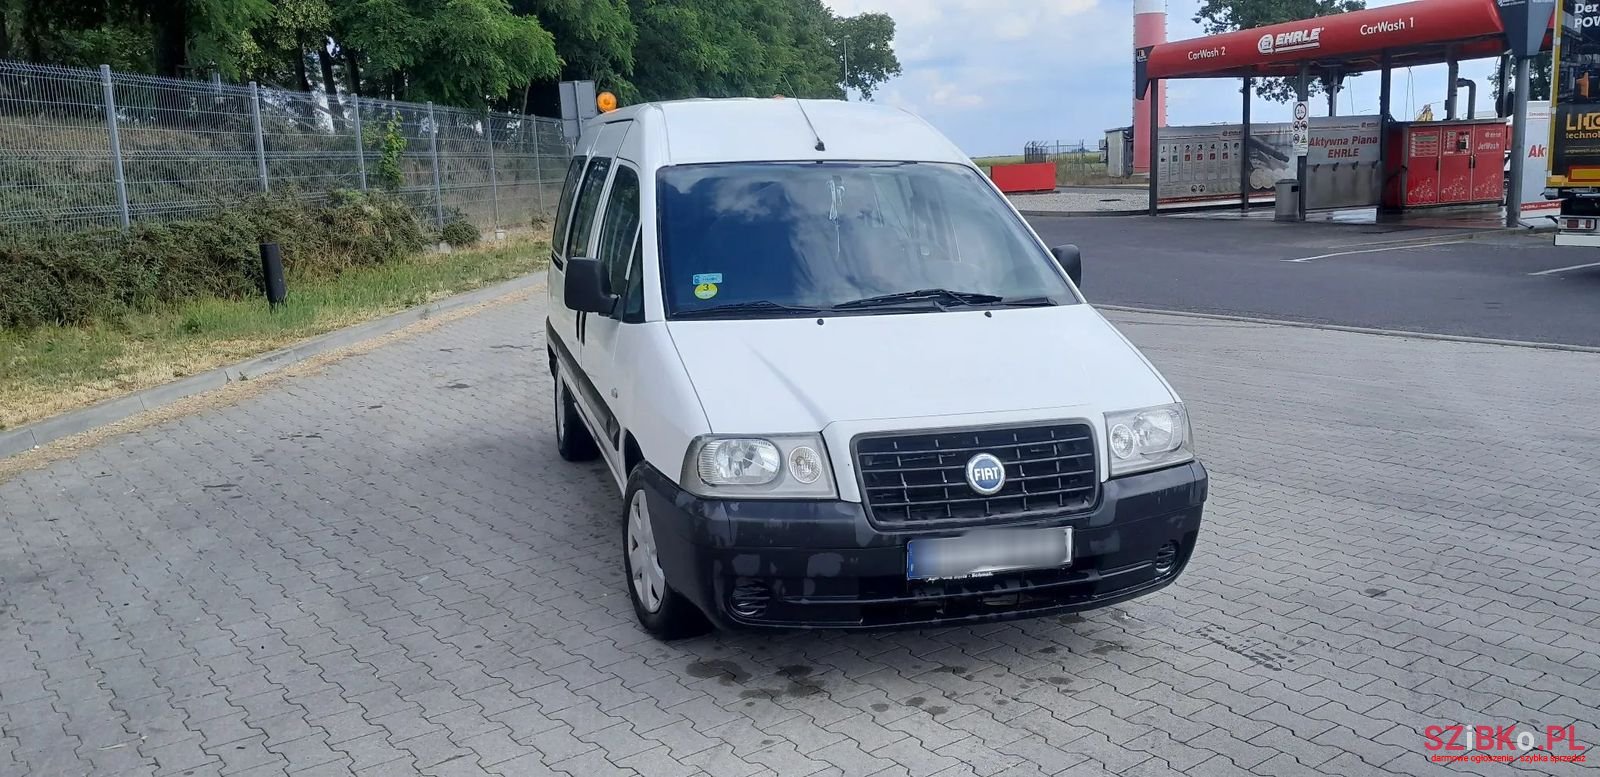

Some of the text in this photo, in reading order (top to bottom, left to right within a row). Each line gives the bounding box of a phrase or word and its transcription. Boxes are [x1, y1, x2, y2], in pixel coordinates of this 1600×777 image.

[1574, 3, 1599, 14] Der
[1360, 17, 1414, 36] CarWash 1
[1275, 28, 1321, 46] EHRLE
[1188, 47, 1226, 61] CarWash 2
[1309, 135, 1378, 149] Aktywna Piana
[1328, 148, 1360, 159] EHRLE
[973, 466, 998, 481] FIAT
